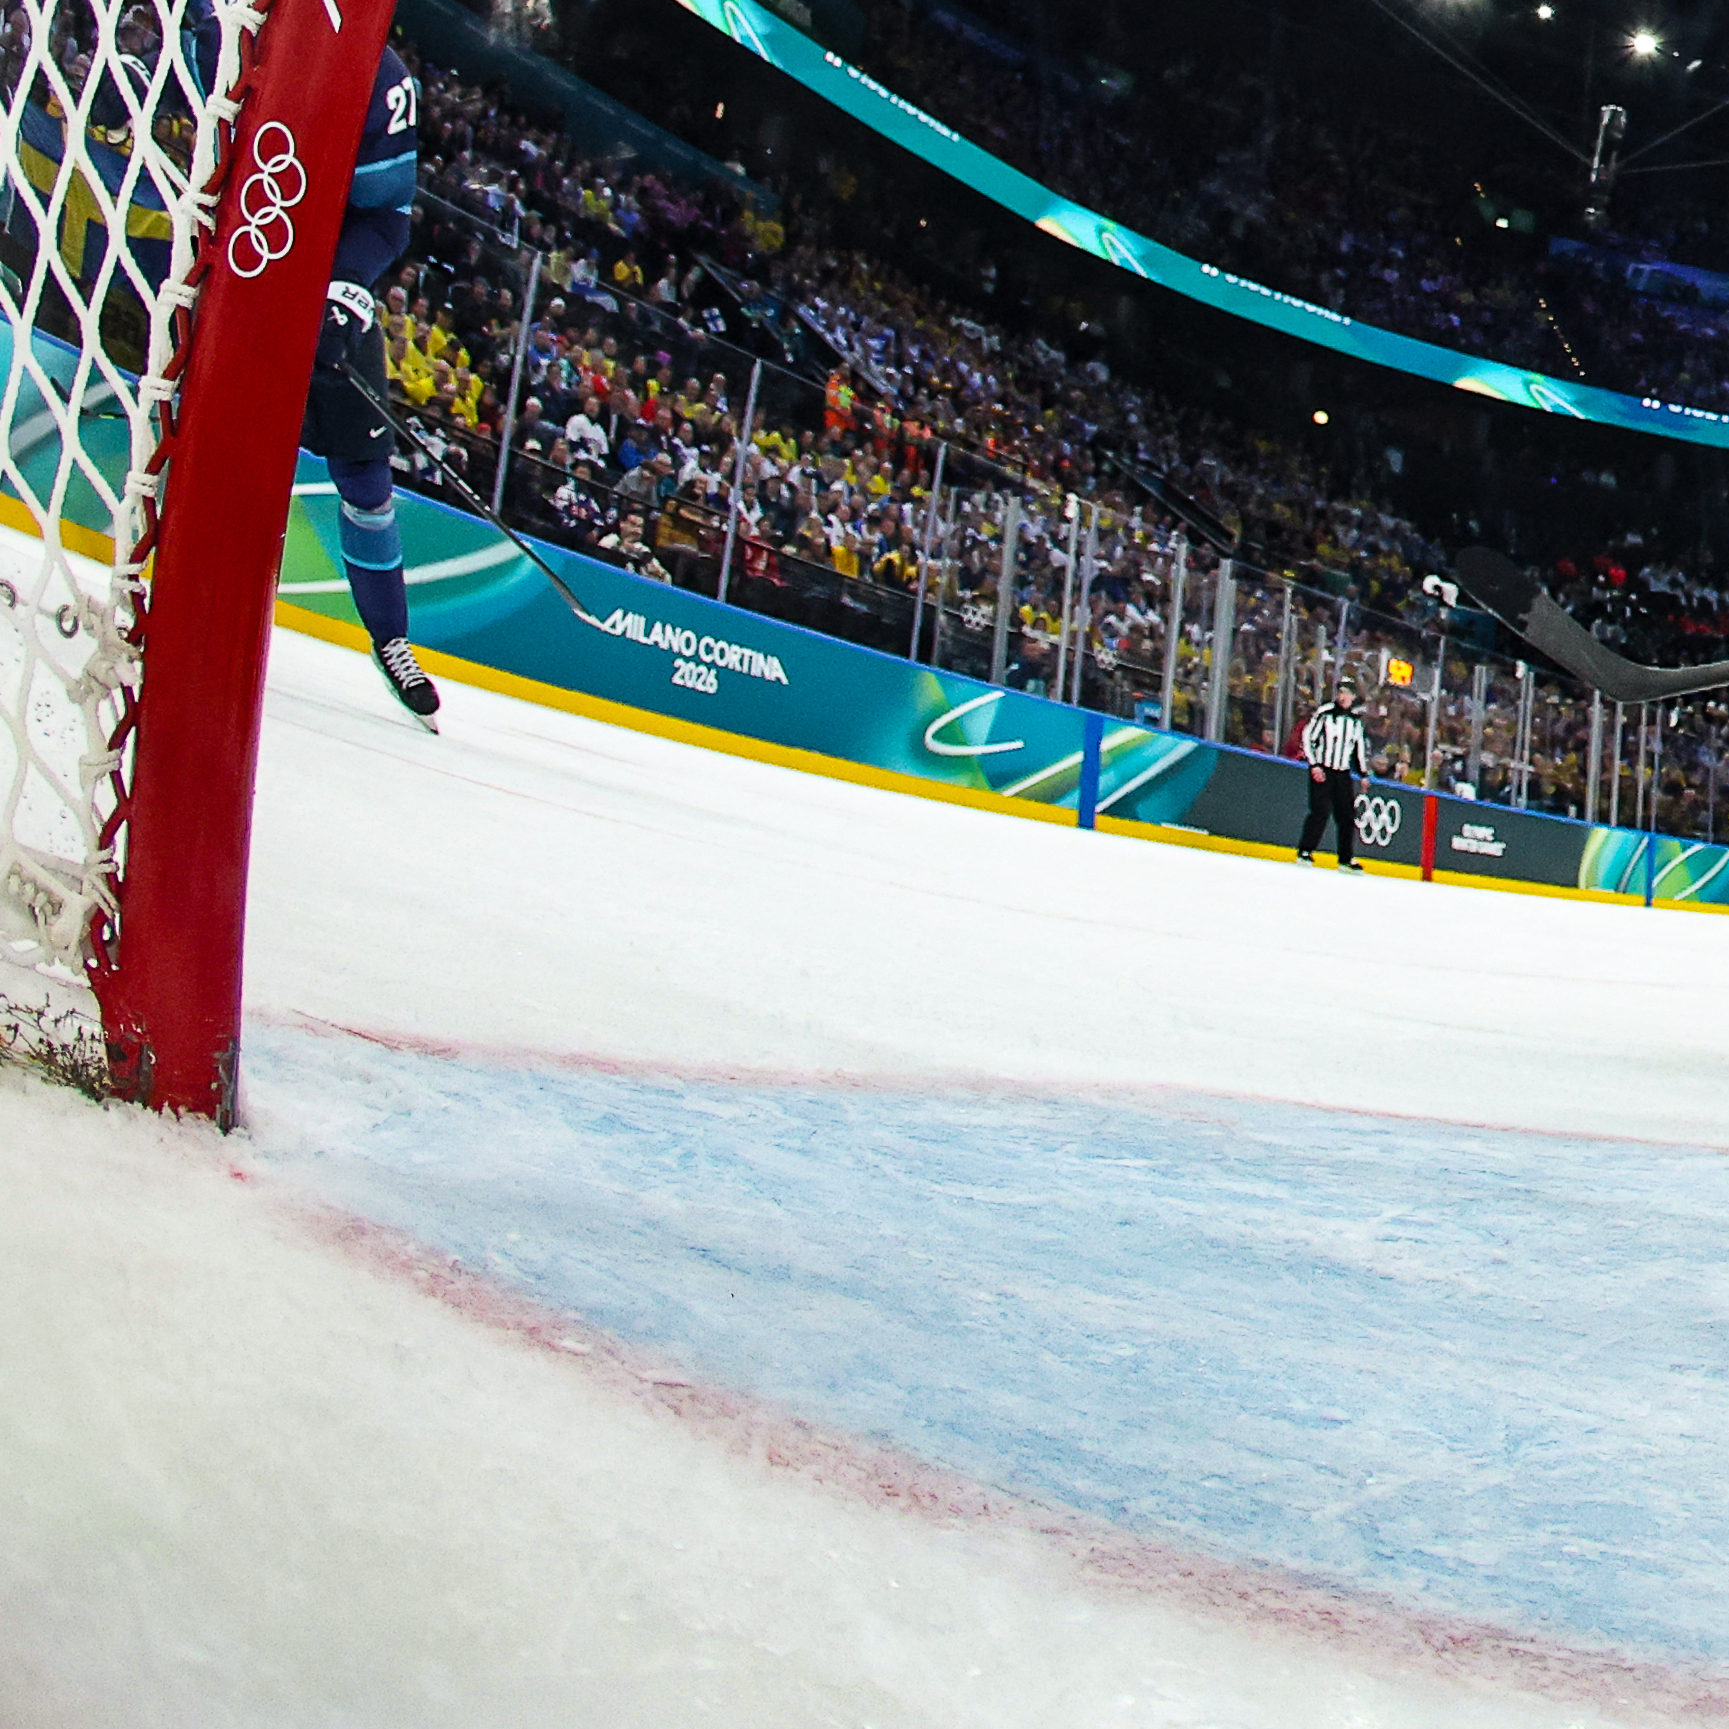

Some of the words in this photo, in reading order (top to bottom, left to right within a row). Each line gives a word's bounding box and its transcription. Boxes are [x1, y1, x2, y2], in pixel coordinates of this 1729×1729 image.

[600, 608, 697, 658] MILANO
[698, 635, 789, 685] CORTINA
[671, 658, 718, 694] 2026
